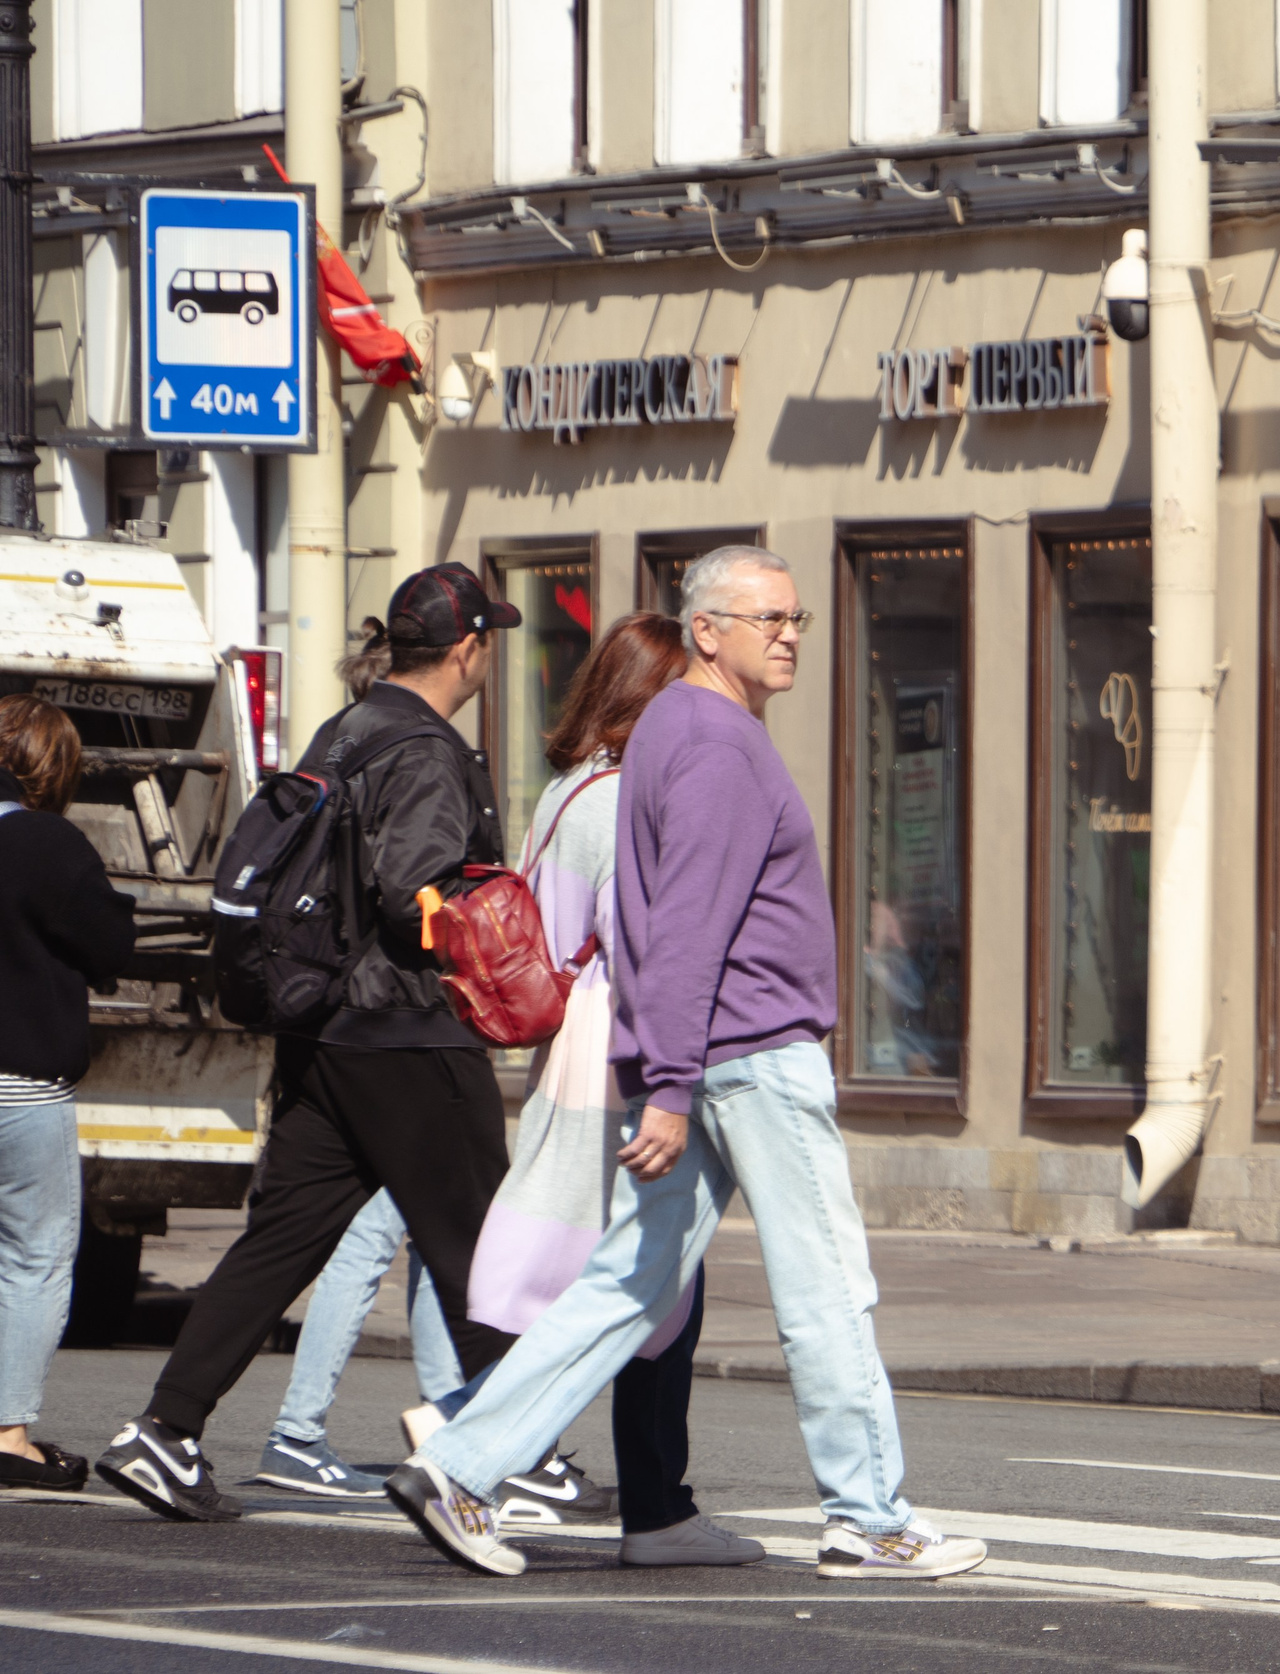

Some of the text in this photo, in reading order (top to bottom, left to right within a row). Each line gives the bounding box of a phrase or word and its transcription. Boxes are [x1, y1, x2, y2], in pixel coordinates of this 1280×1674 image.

[500, 355, 734, 445] КОНДИТЕРСКАЯ
[878, 320, 1109, 421] ТОРТ ПЕРВЫЙ
